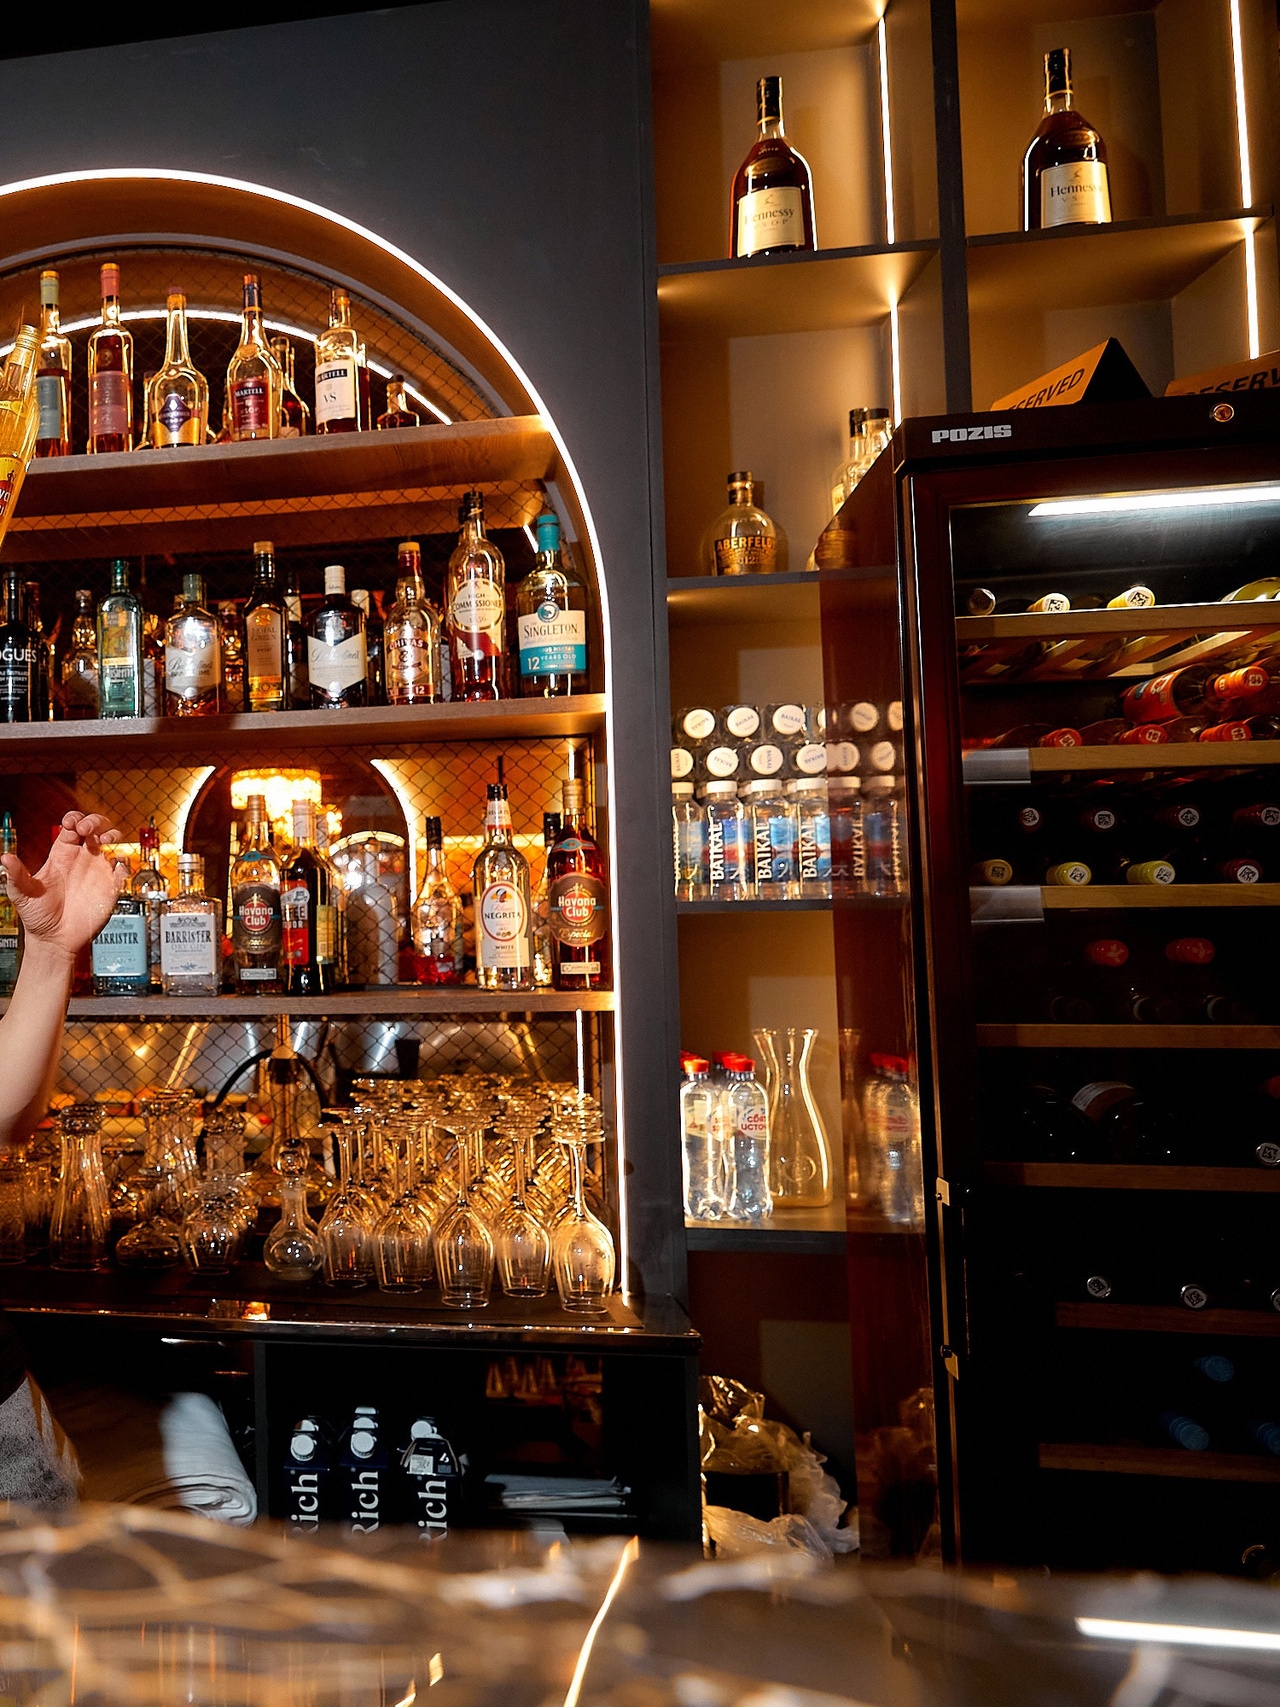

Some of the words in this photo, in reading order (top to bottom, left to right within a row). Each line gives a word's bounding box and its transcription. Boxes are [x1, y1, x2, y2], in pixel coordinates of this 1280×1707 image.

[235, 386, 264, 398] MARTELL
[1007, 368, 1085, 410] SERVED
[931, 425, 1012, 444] POZIS
[452, 599, 502, 612] COMMSSIONER
[523, 623, 578, 639] SINGLETON
[527, 656, 540, 671] 12
[415, 686, 426, 695] 12
[558, 896, 597, 907] Havana
[238, 904, 274, 916] Havana
[484, 911, 522, 920] NEGRITA
[565, 908, 589, 917] Club
[245, 915, 266, 926] Club
[165, 930, 212, 943] BARRISTER
